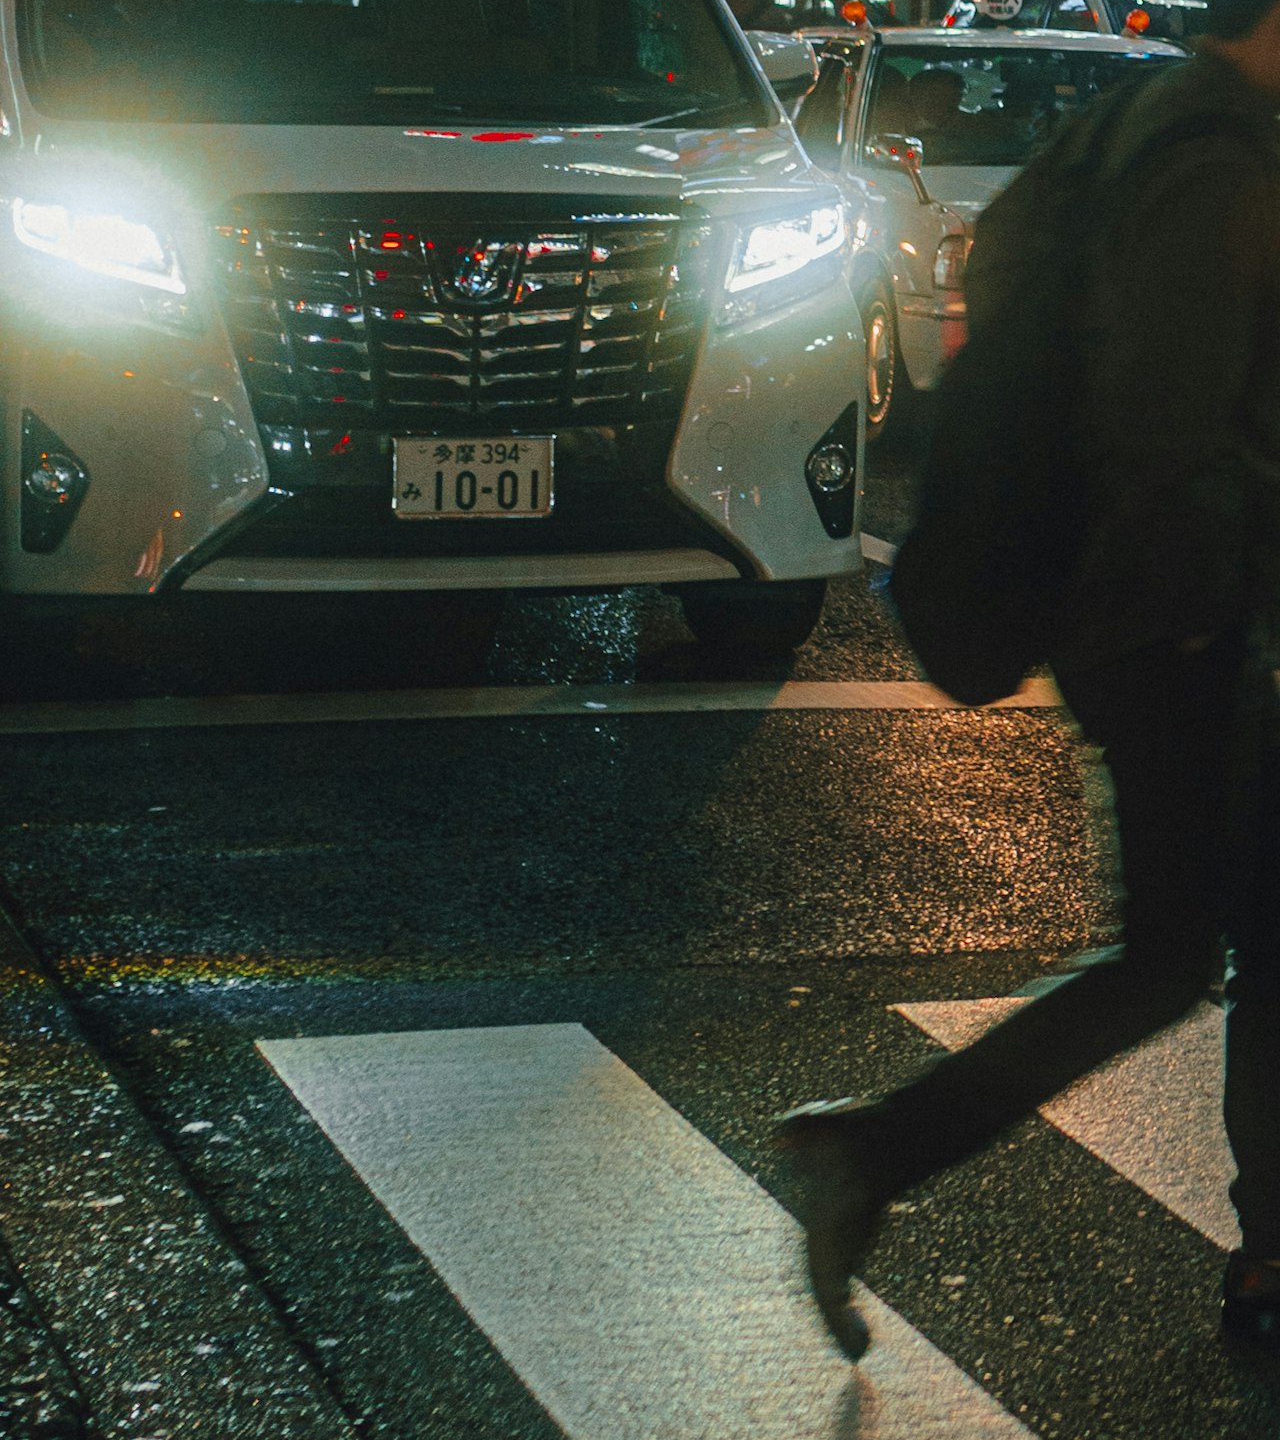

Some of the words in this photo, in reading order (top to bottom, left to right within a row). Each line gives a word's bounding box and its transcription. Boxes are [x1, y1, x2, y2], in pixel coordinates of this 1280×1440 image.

[432, 443, 476, 465] 多摩
[481, 443, 521, 464] 394
[401, 482, 422, 501] み
[434, 469, 539, 512] 10-01
